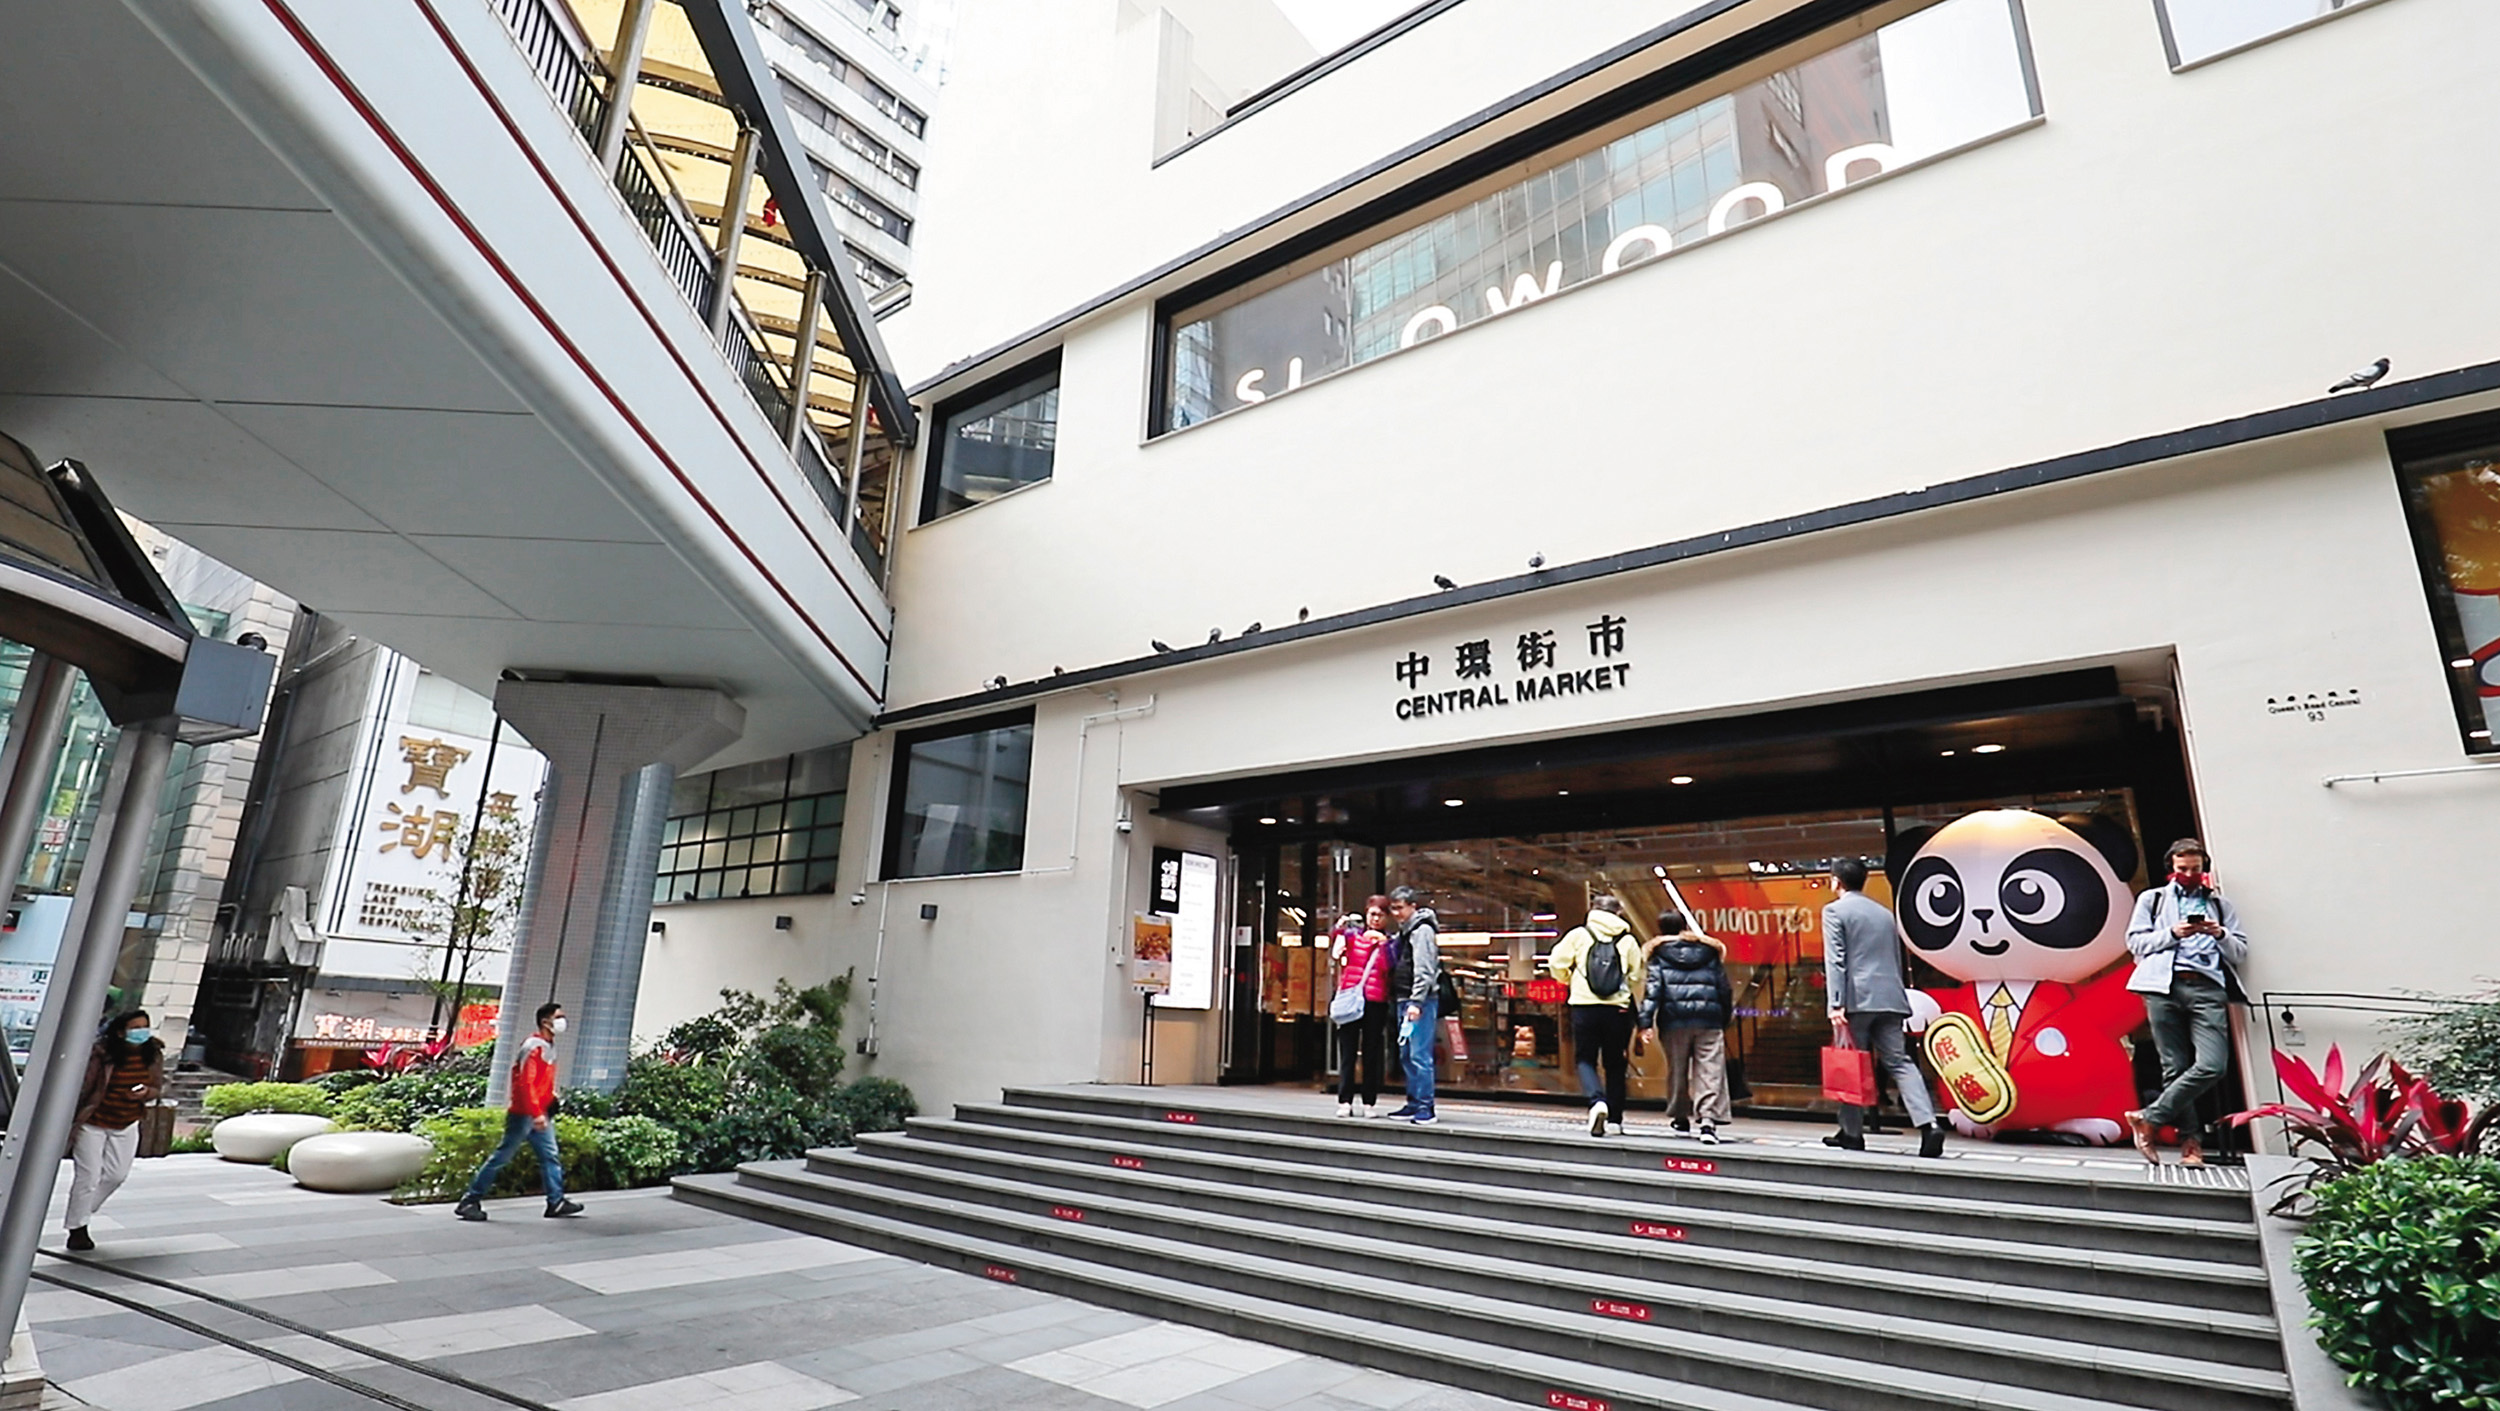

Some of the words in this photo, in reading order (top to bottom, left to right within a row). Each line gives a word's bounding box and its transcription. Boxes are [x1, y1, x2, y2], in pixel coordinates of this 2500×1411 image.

[1396, 615, 1627, 690] 中環街市
[1396, 683, 1509, 720] CENTRAL
[1516, 663, 1631, 702] MARKET
[2307, 711, 2325, 721] 93
[379, 735, 473, 863] 寶湖
[363, 894, 397, 906] LAKE
